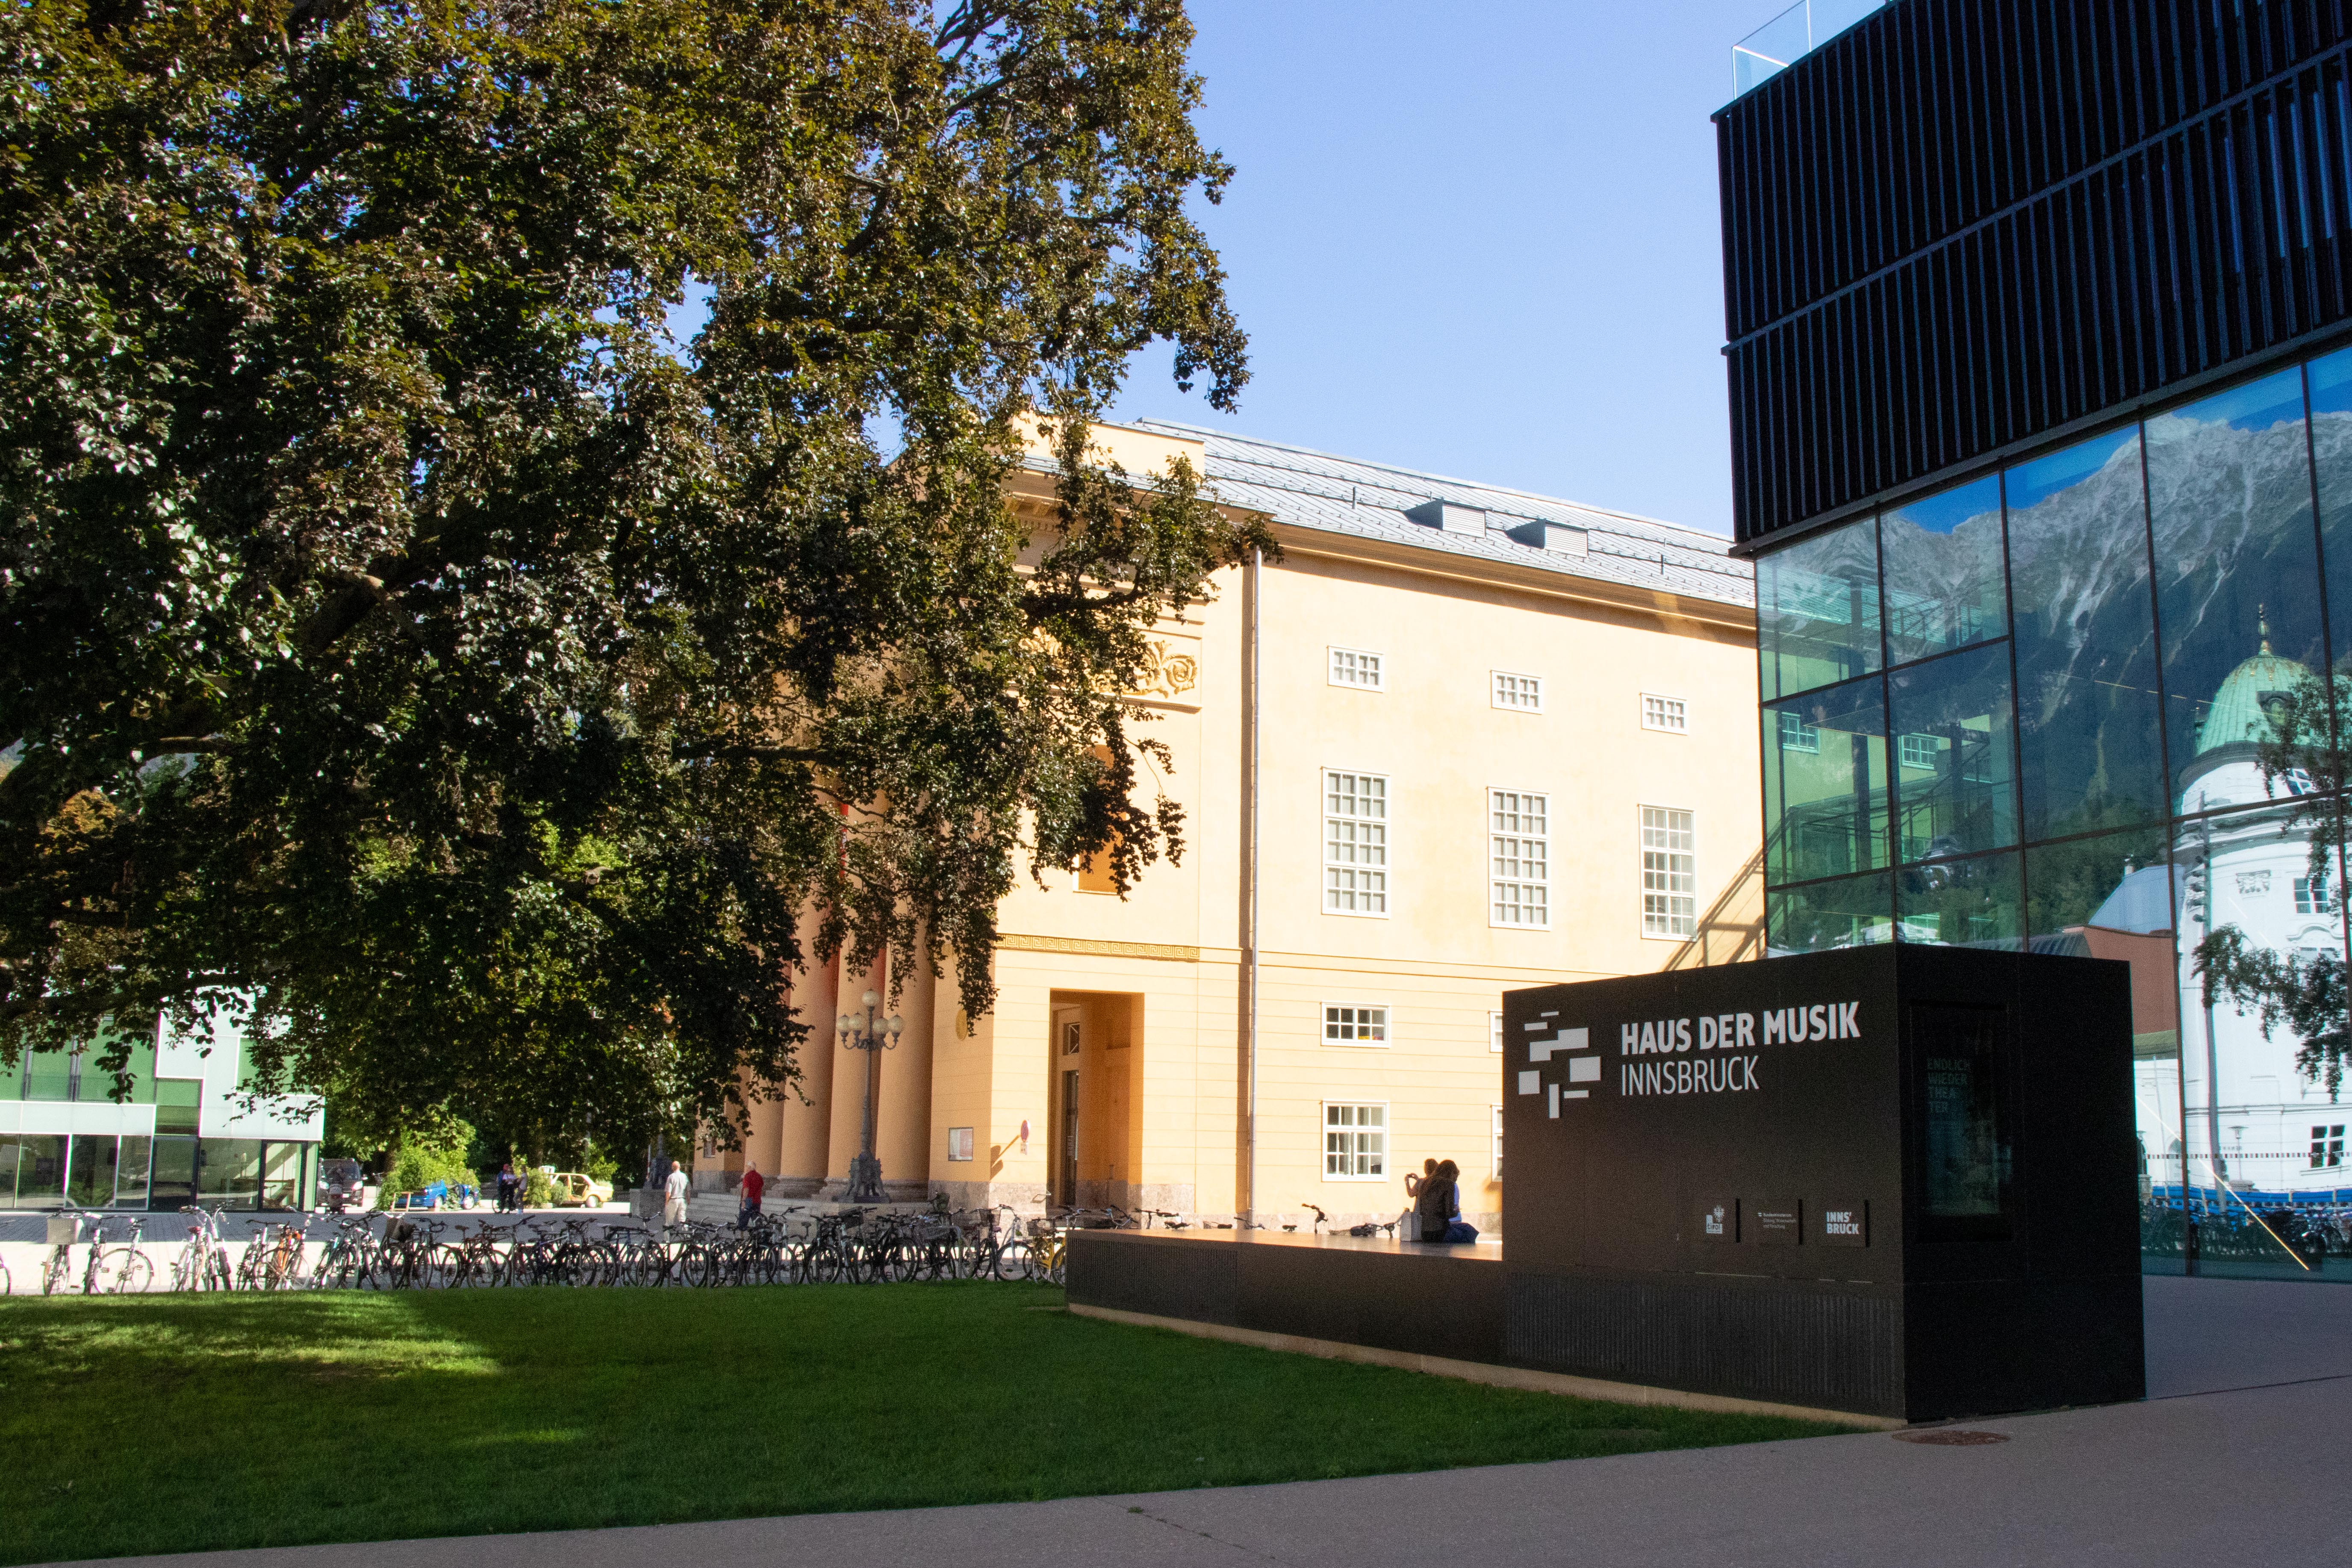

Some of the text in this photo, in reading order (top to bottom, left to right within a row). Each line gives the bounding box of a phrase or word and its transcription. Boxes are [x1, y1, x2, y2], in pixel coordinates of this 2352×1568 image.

[1621, 1001, 1861, 1055] HAUS DER MUSIK
[1927, 1058, 1970, 1071] ENDLICH
[1621, 1055, 1760, 1096] INNSBRUCK
[1928, 1073, 1968, 1086] WIEDER
[1928, 1101, 1948, 1114] TER
[1827, 1223, 1860, 1234] BRUCK
